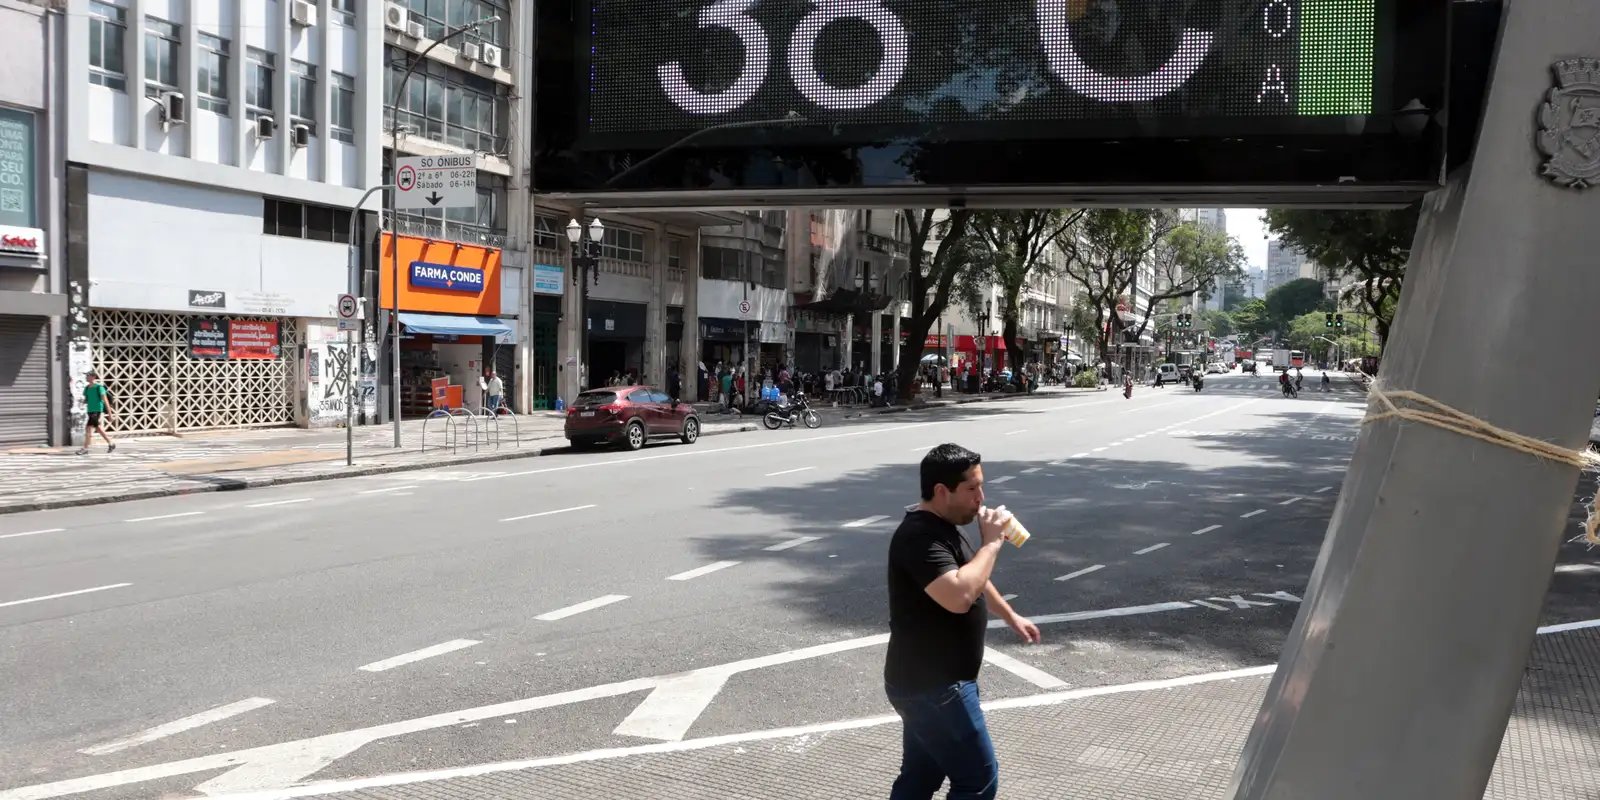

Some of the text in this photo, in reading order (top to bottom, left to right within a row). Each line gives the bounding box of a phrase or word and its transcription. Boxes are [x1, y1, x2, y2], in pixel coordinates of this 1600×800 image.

[1, 160, 23, 174] SEU
[437, 155, 471, 167] ÔNIBUS
[414, 266, 482, 283] FARMA CONDE
